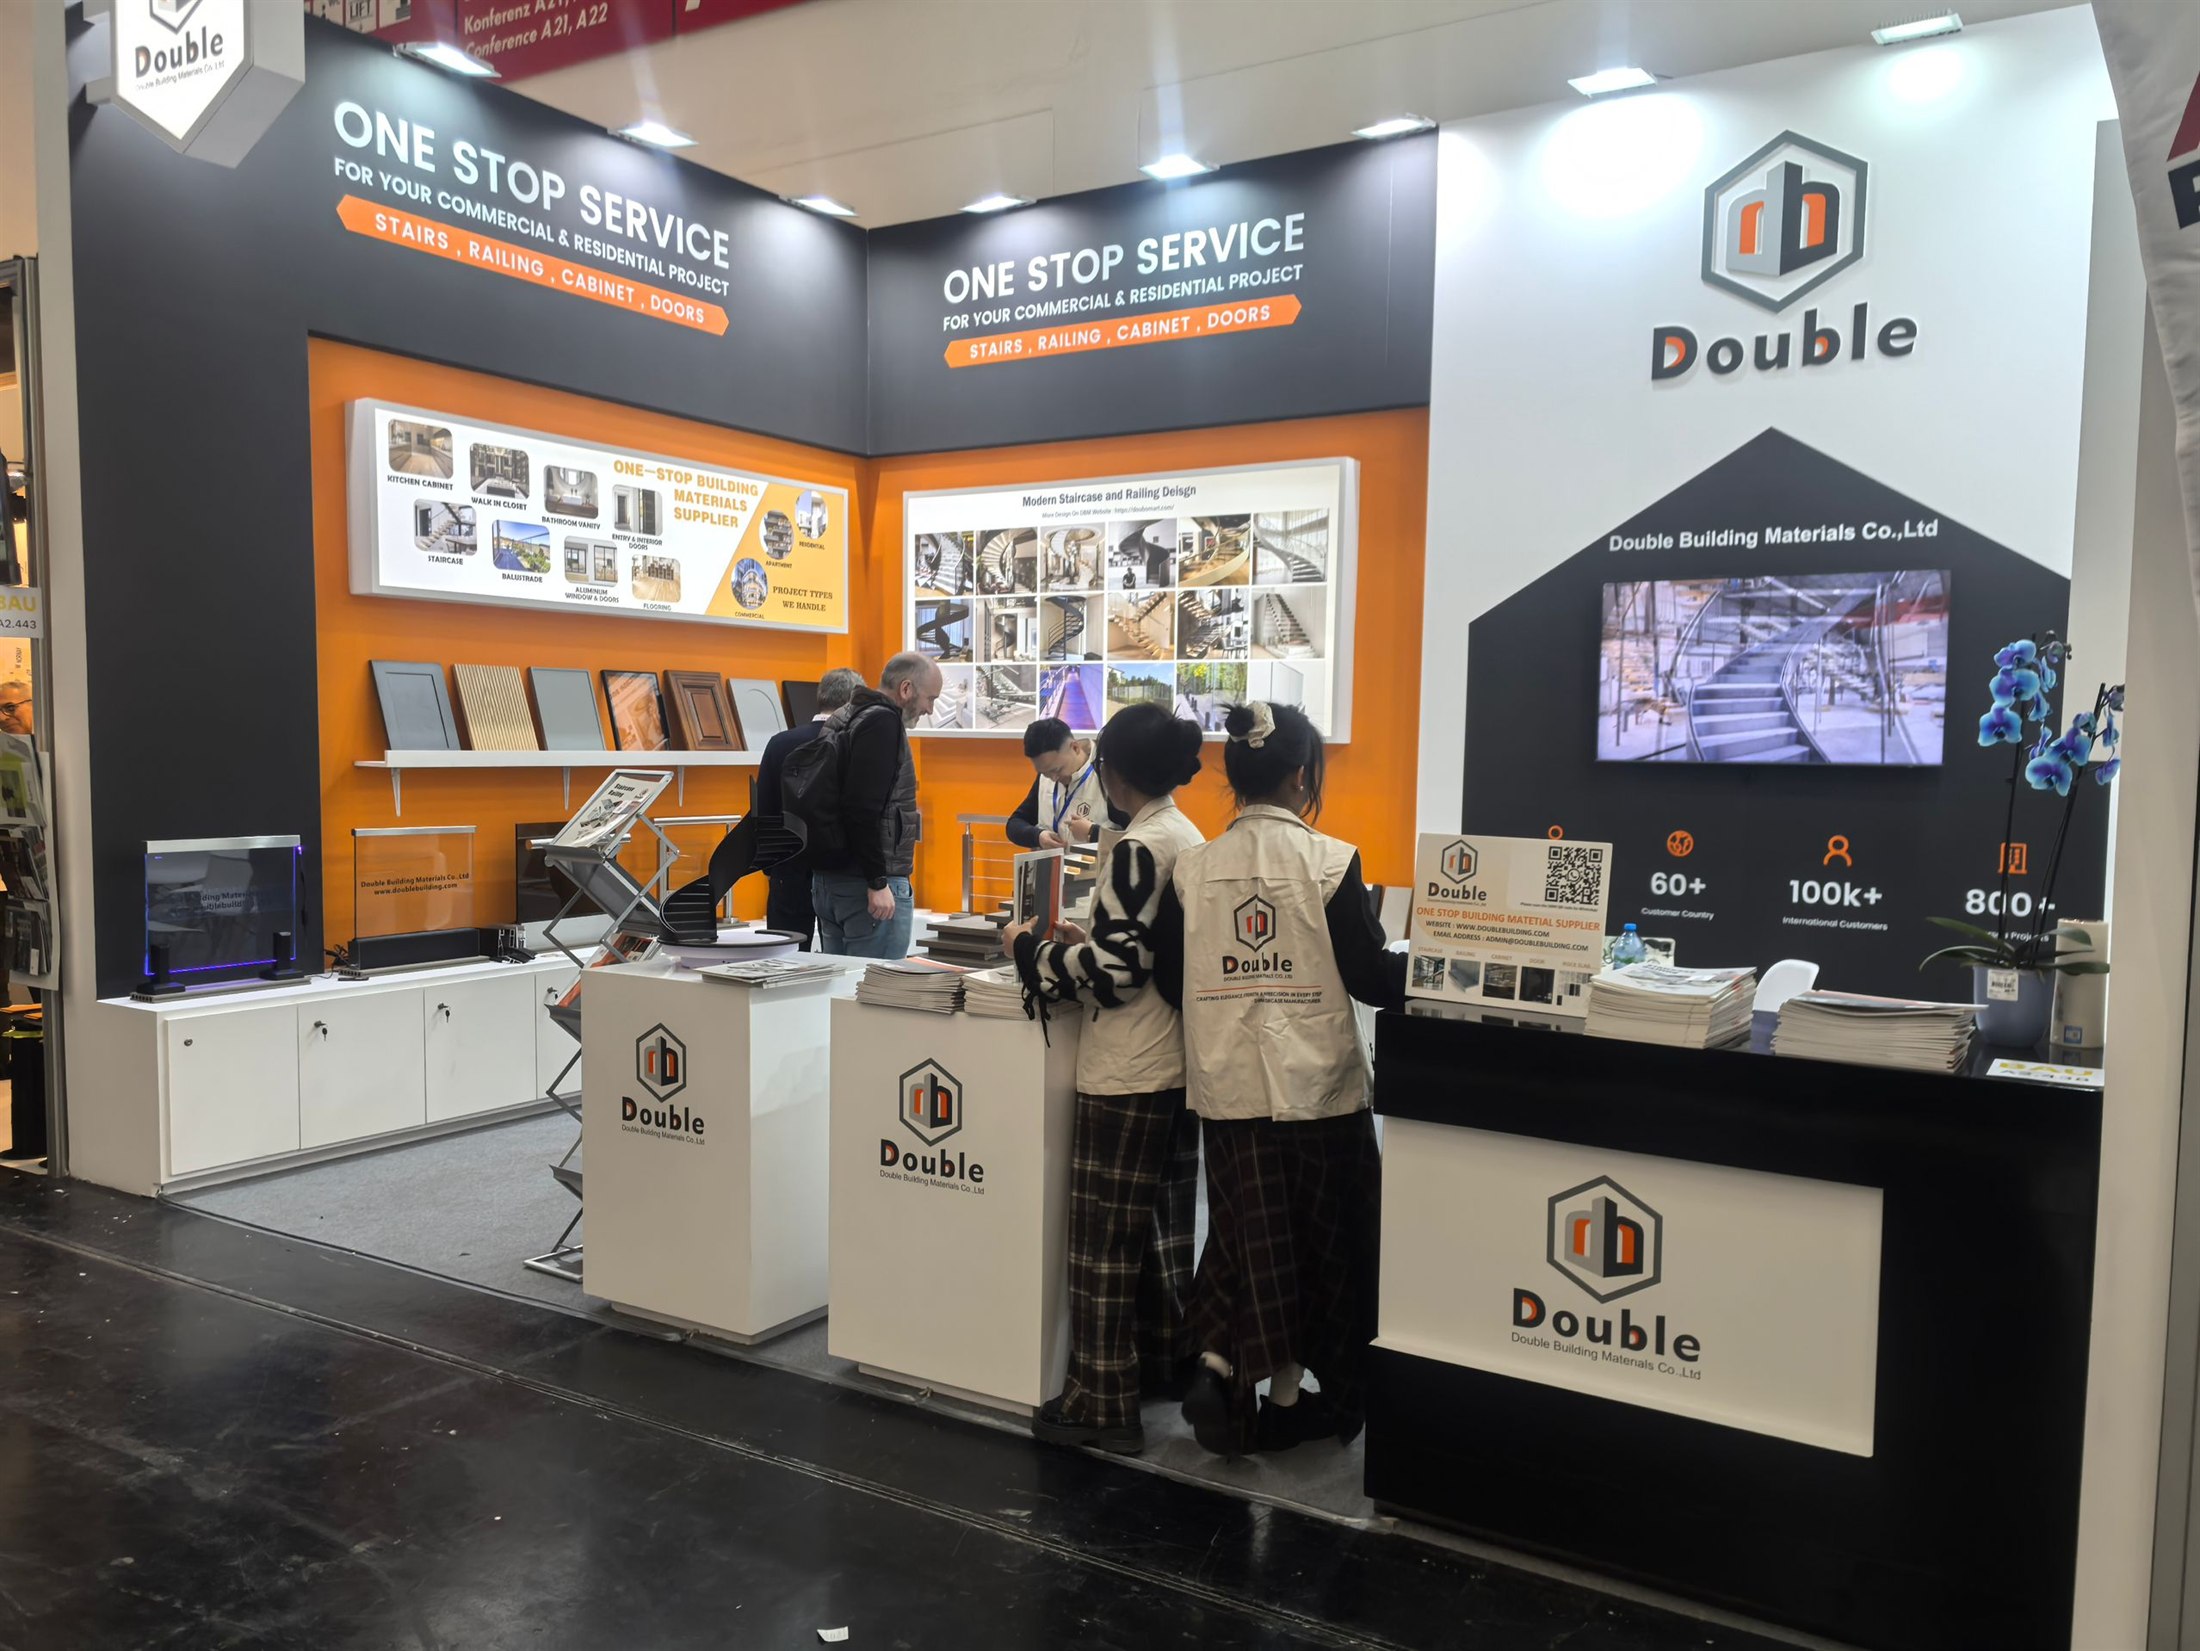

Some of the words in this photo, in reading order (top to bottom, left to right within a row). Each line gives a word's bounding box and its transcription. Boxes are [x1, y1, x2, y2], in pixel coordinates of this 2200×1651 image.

[464, 4, 531, 35] Konferenz
[465, 30, 537, 58] Conference
[576, 2, 608, 30] A22
[135, 26, 224, 79] Double
[334, 101, 436, 173] ONE
[452, 140, 566, 211] STOP
[579, 184, 730, 270] SERVICE
[334, 157, 373, 187] FOR
[379, 171, 432, 205] YOUR
[437, 190, 554, 243] COMMERCIAL
[558, 228, 570, 247] &
[574, 233, 666, 278] RESIDENTIAL
[668, 263, 730, 297] PROJECT
[375, 212, 449, 250] STAIRS
[469, 240, 544, 277] RAILING
[562, 268, 635, 304] CABINET
[650, 293, 705, 324] DOORS
[943, 260, 1015, 304] ONE
[1027, 244, 1124, 292] STOP
[1136, 212, 1305, 276] SERVICE
[943, 315, 970, 332] FOR
[973, 307, 1011, 327] YOUR
[1015, 293, 1111, 321] COMMERCIAL
[1114, 290, 1126, 306] &
[1129, 278, 1225, 304] RESIDENTIAL
[1228, 264, 1304, 290] PROJECT
[969, 339, 1023, 360] STAIRS
[1037, 328, 1102, 351] RAILING
[1116, 316, 1190, 341] CABINET
[1207, 305, 1271, 329] DOORS
[1651, 301, 1919, 381] Double
[387, 474, 420, 487] KITCHEN
[422, 479, 454, 491] CABINET
[697, 474, 759, 497] BUILDING
[471, 496, 492, 506] WALK
[493, 499, 502, 508] IN
[503, 500, 527, 511] CLOSET
[674, 489, 748, 511] MATERIALS
[1022, 496, 1057, 507] Modern
[1059, 492, 1103, 505] Staircase
[1105, 489, 1123, 501] and
[1125, 487, 1160, 500] Railing
[541, 516, 578, 528] BATHROOM
[578, 519, 601, 530] VANITY
[674, 508, 739, 528] SUPPLIER
[612, 533, 630, 542] ENTRY
[636, 537, 663, 546] INTERIOR
[628, 543, 648, 551] DOORS
[1608, 532, 1674, 551] Double
[1679, 528, 1758, 549] Building
[1764, 523, 1856, 544] Materials
[428, 555, 464, 566] STAIRCASE
[765, 560, 793, 569] APARTMENT
[501, 573, 543, 583] BALUSTRADE
[565, 592, 593, 601] WINDOW
[599, 595, 619, 603] DOORS
[575, 586, 608, 595] ALUMINUM
[772, 586, 808, 598] PROJECT
[809, 590, 833, 600] TYPES
[643, 603, 671, 611] FLOORING
[782, 600, 795, 608] WE
[796, 602, 826, 612] HANDLE
[361, 879, 385, 888] Double
[386, 877, 415, 886] Building
[415, 874, 446, 883] Materials
[1428, 882, 1487, 901] Double
[1650, 872, 1707, 896] 60+
[1789, 879, 1883, 907] 100k+
[1416, 906, 1435, 917] ONE
[1437, 908, 1460, 918] STOP
[1462, 911, 1505, 923] BUILDING
[1555, 919, 1601, 931] SUPPLIER
[1641, 907, 1680, 917] Customer
[1681, 910, 1714, 921] Country
[1782, 916, 1838, 928] International
[1839, 920, 1889, 931] Customers
[1426, 920, 1452, 929] WEBSITE
[1456, 923, 1550, 938] WWW.DOUBLEBUILDING.COM
[1433, 930, 1452, 939] EMAIL
[1453, 932, 1481, 941] ADDRESS
[1222, 952, 1293, 974] Double
[622, 1096, 705, 1135] Double
[621, 1124, 639, 1133] Double
[640, 1127, 661, 1138] Building
[662, 1131, 685, 1142] Materials
[880, 1139, 984, 1183] Double
[880, 1169, 902, 1180] Double
[903, 1173, 929, 1187] Building
[930, 1178, 960, 1191] Materials
[1513, 1287, 1701, 1363] Double
[1511, 1331, 1550, 1349] Double
[1553, 1340, 1599, 1361] Building
[1601, 1350, 1655, 1371] Materials
